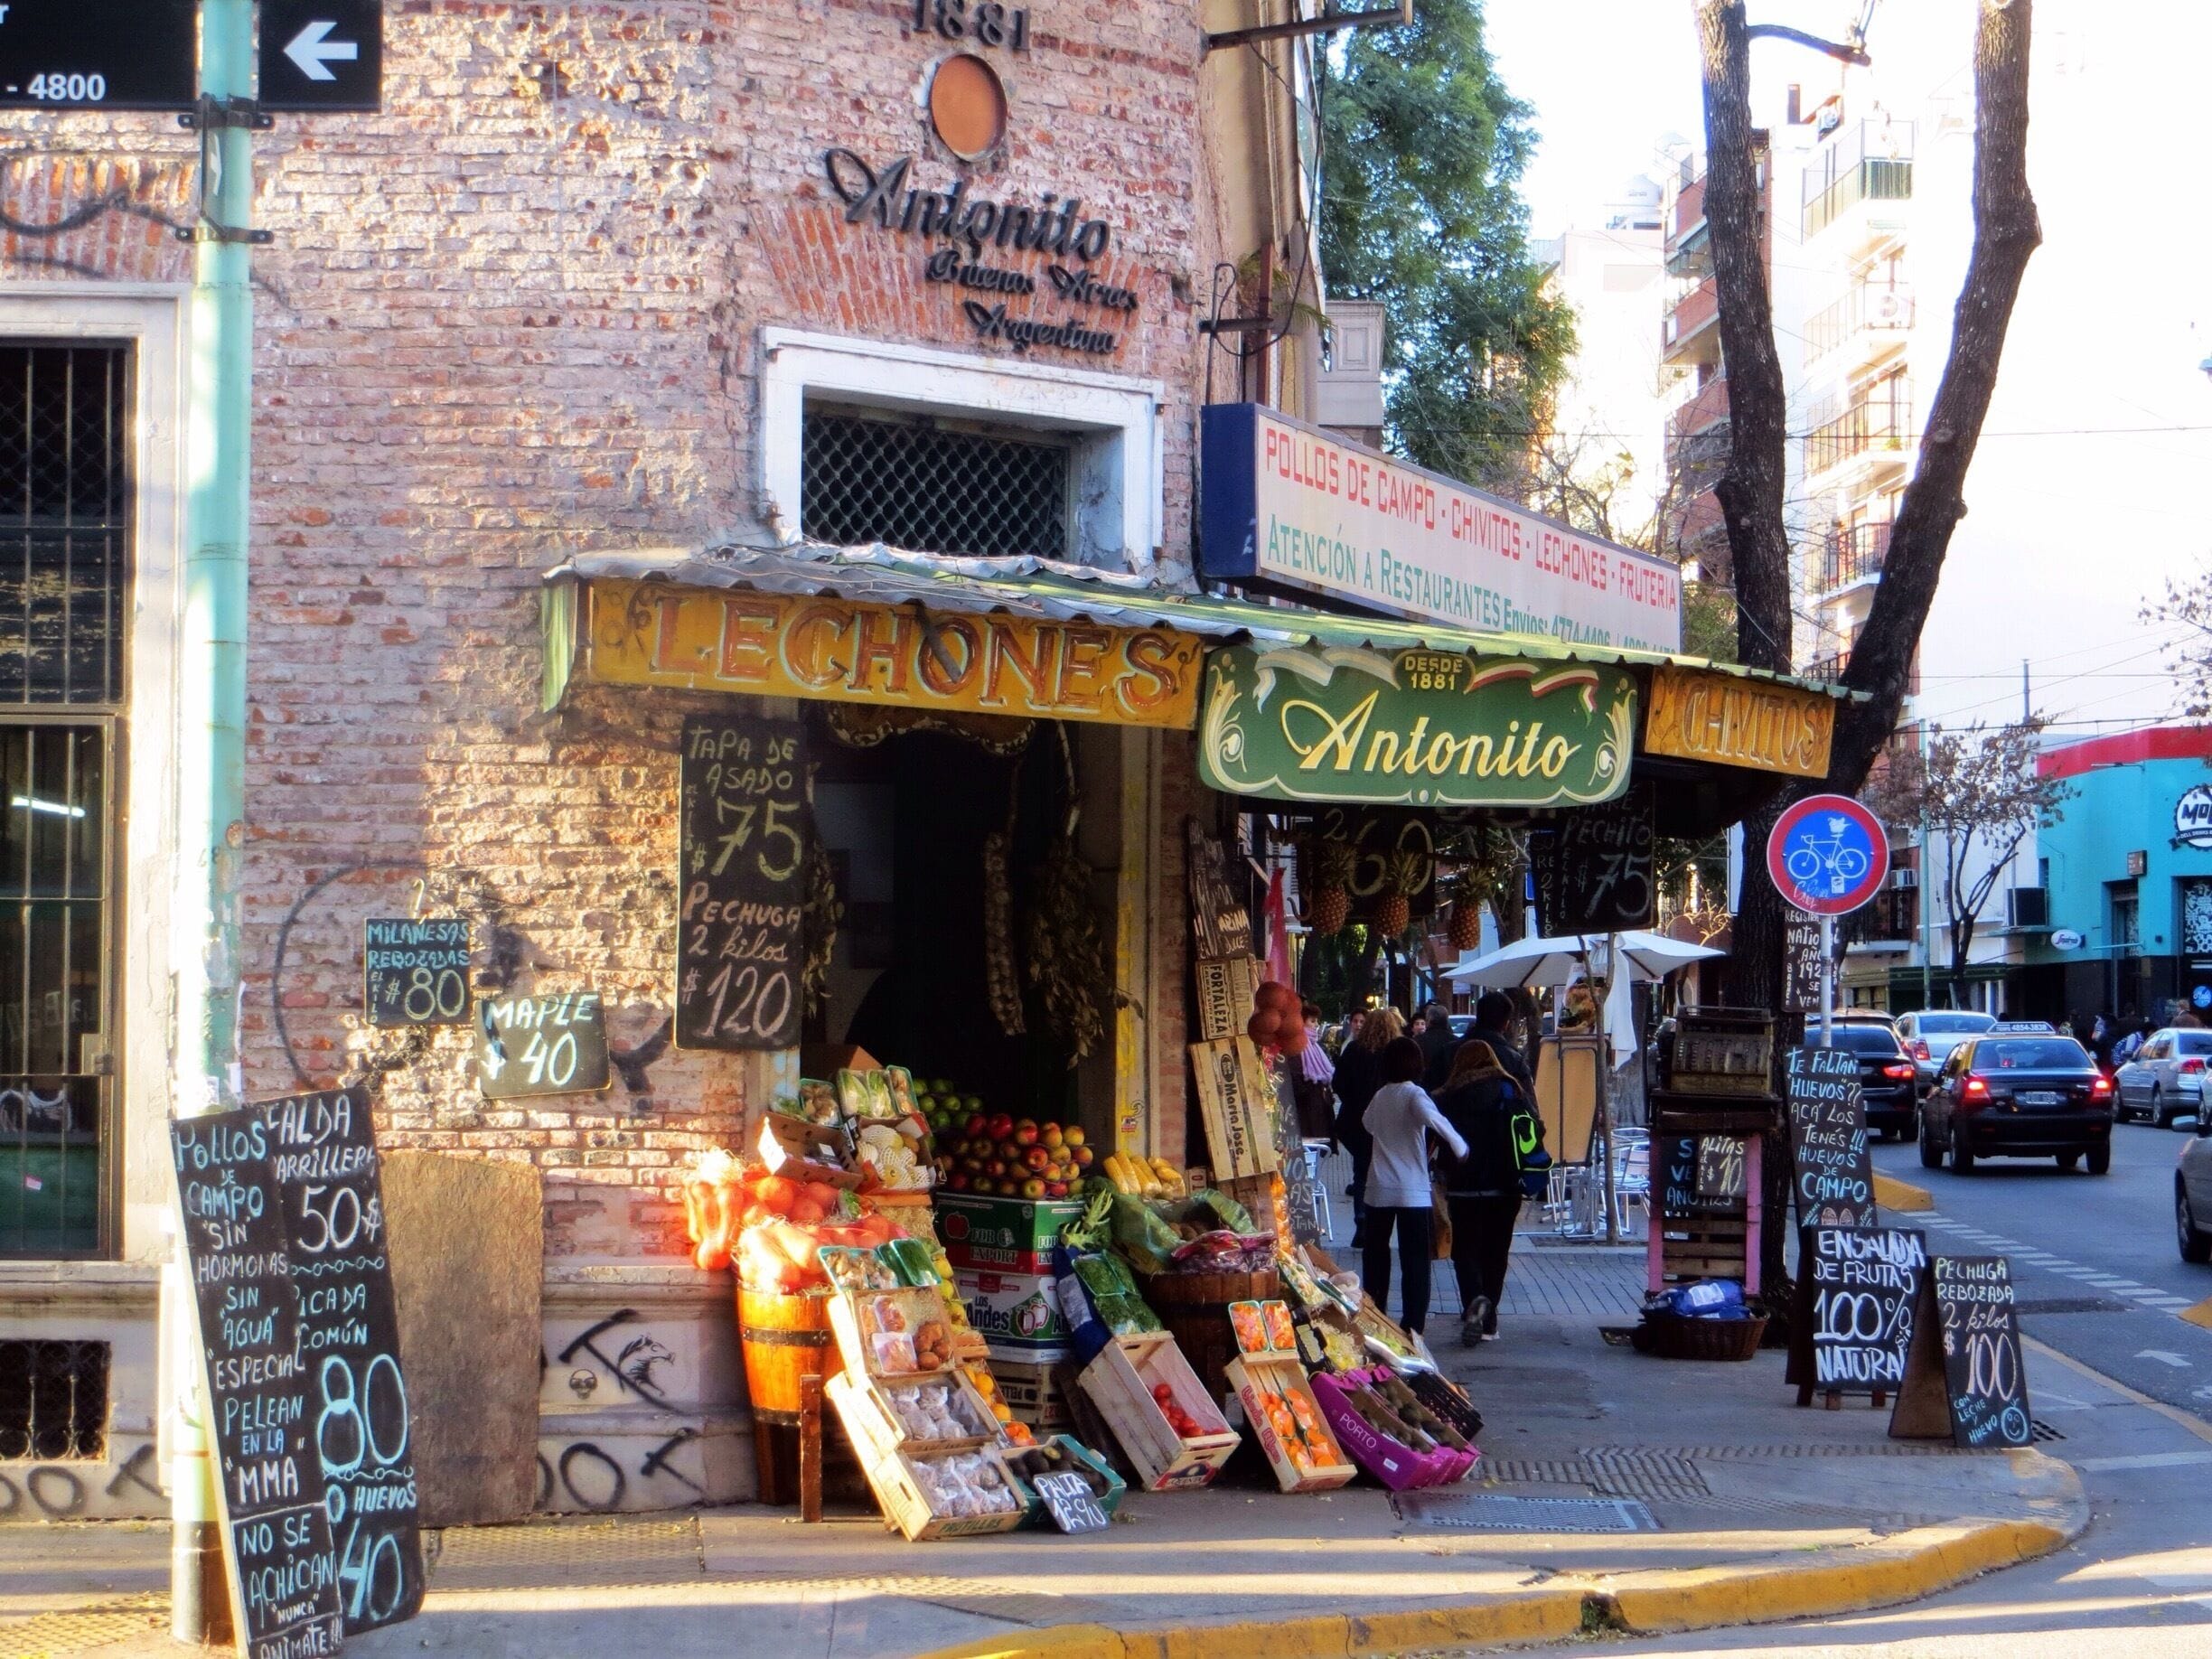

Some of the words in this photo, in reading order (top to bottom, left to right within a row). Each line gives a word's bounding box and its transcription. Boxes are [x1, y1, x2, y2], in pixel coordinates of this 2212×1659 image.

[914, 0, 1030, 51] 1881
[27, 73, 106, 101] 4800
[825, 148, 1111, 261] Antonito
[924, 249, 1036, 295] Buenos
[1048, 265, 1138, 310] Aires
[963, 300, 1119, 354] Argentina
[1266, 427, 1339, 495] POLLOS
[1347, 458, 1370, 507] DE
[1378, 470, 1435, 530] CAMPO
[1452, 498, 1521, 561] CHIVITOS
[1536, 530, 1607, 591] LECHONES
[1619, 560, 1677, 612] FRUTERIA
[1381, 548, 1500, 628] RESTAURANTES
[651, 595, 1180, 718] LECHONES
[1404, 656, 1465, 675] DESDE
[1410, 672, 1457, 692] 1881
[1282, 689, 1581, 779] Antonito
[1682, 675, 1816, 769] CHIVITOS
[688, 724, 752, 760] TAPA
[768, 738, 799, 764] DE
[706, 762, 793, 796] ASADO
[681, 881, 801, 932] PECHUGA
[688, 925, 709, 957] 2
[719, 925, 788, 961] kilos
[485, 993, 599, 1030] MAPLE
[1209, 963, 1224, 1035] FORTALEZA
[1786, 1046, 1805, 1073] TE
[1811, 1050, 1857, 1075] FALTAN
[1791, 1102, 1823, 1123] ACÁ
[1827, 1103, 1855, 1126] LOS
[176, 1120, 267, 1172] POLLOS
[1798, 1145, 1857, 1168] HUEVOS
[220, 1169, 236, 1187] DE
[1801, 1171, 1868, 1204] CAMPO
[1822, 1165, 1838, 1176] DE
[185, 1181, 264, 1221] CAMPO
[1817, 1229, 1926, 1268] ENSALADA
[1814, 1256, 1841, 1280] DE
[1843, 1261, 1915, 1294] FRUTAS
[1936, 1257, 2008, 1280] PECHUGA
[226, 1287, 259, 1310] SIN
[975, 1295, 989, 1308] LOS
[1936, 1282, 2014, 1305] REBOZADA
[966, 1302, 1011, 1332] Andes
[1943, 1301, 1961, 1328] 2
[1965, 1303, 2010, 1332] kilos
[225, 1393, 305, 1436] PELEAN
[317, 1353, 408, 1475] 80
[1958, 1398, 1987, 1423] LECHE
[1967, 1413, 1999, 1444] HUEVO
[241, 1435, 260, 1456] EN
[266, 1429, 285, 1455] LA
[1339, 1411, 1378, 1450] PORTO
[354, 1481, 417, 1514] HUEVOS
[242, 1525, 273, 1556] NO
[284, 1513, 312, 1548] SE
[340, 1518, 403, 1622] 40
